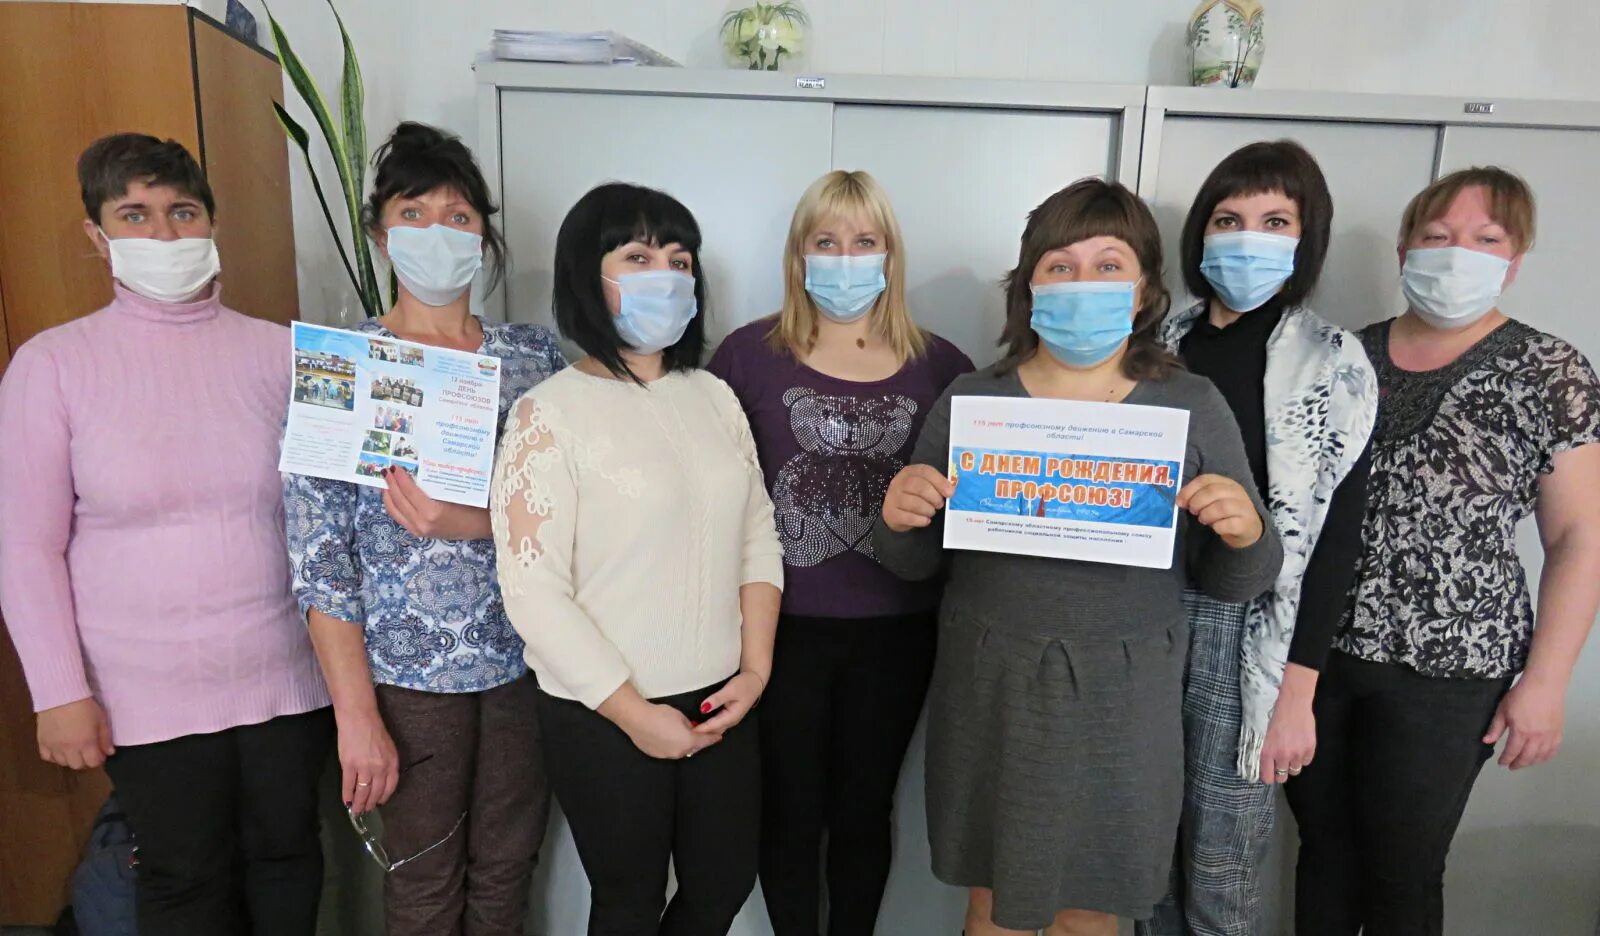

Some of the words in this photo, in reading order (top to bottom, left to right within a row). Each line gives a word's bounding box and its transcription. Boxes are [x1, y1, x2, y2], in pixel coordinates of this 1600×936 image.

[442, 389, 491, 404] ПРОФСОЮЗОВ
[458, 385, 477, 394] ДЕНЬ
[1005, 423, 1066, 431] профсоюзному
[1067, 425, 1109, 434] движению
[1118, 428, 1164, 438] Самарской
[1046, 433, 1084, 441] области!
[442, 438, 480, 450] Самарской
[960, 450, 975, 471] С
[979, 453, 1041, 475] ДНЕМ
[1045, 457, 1175, 488] РОЖДЕНИЯ,
[995, 479, 1133, 509] ПРОФСОЮЗ!
